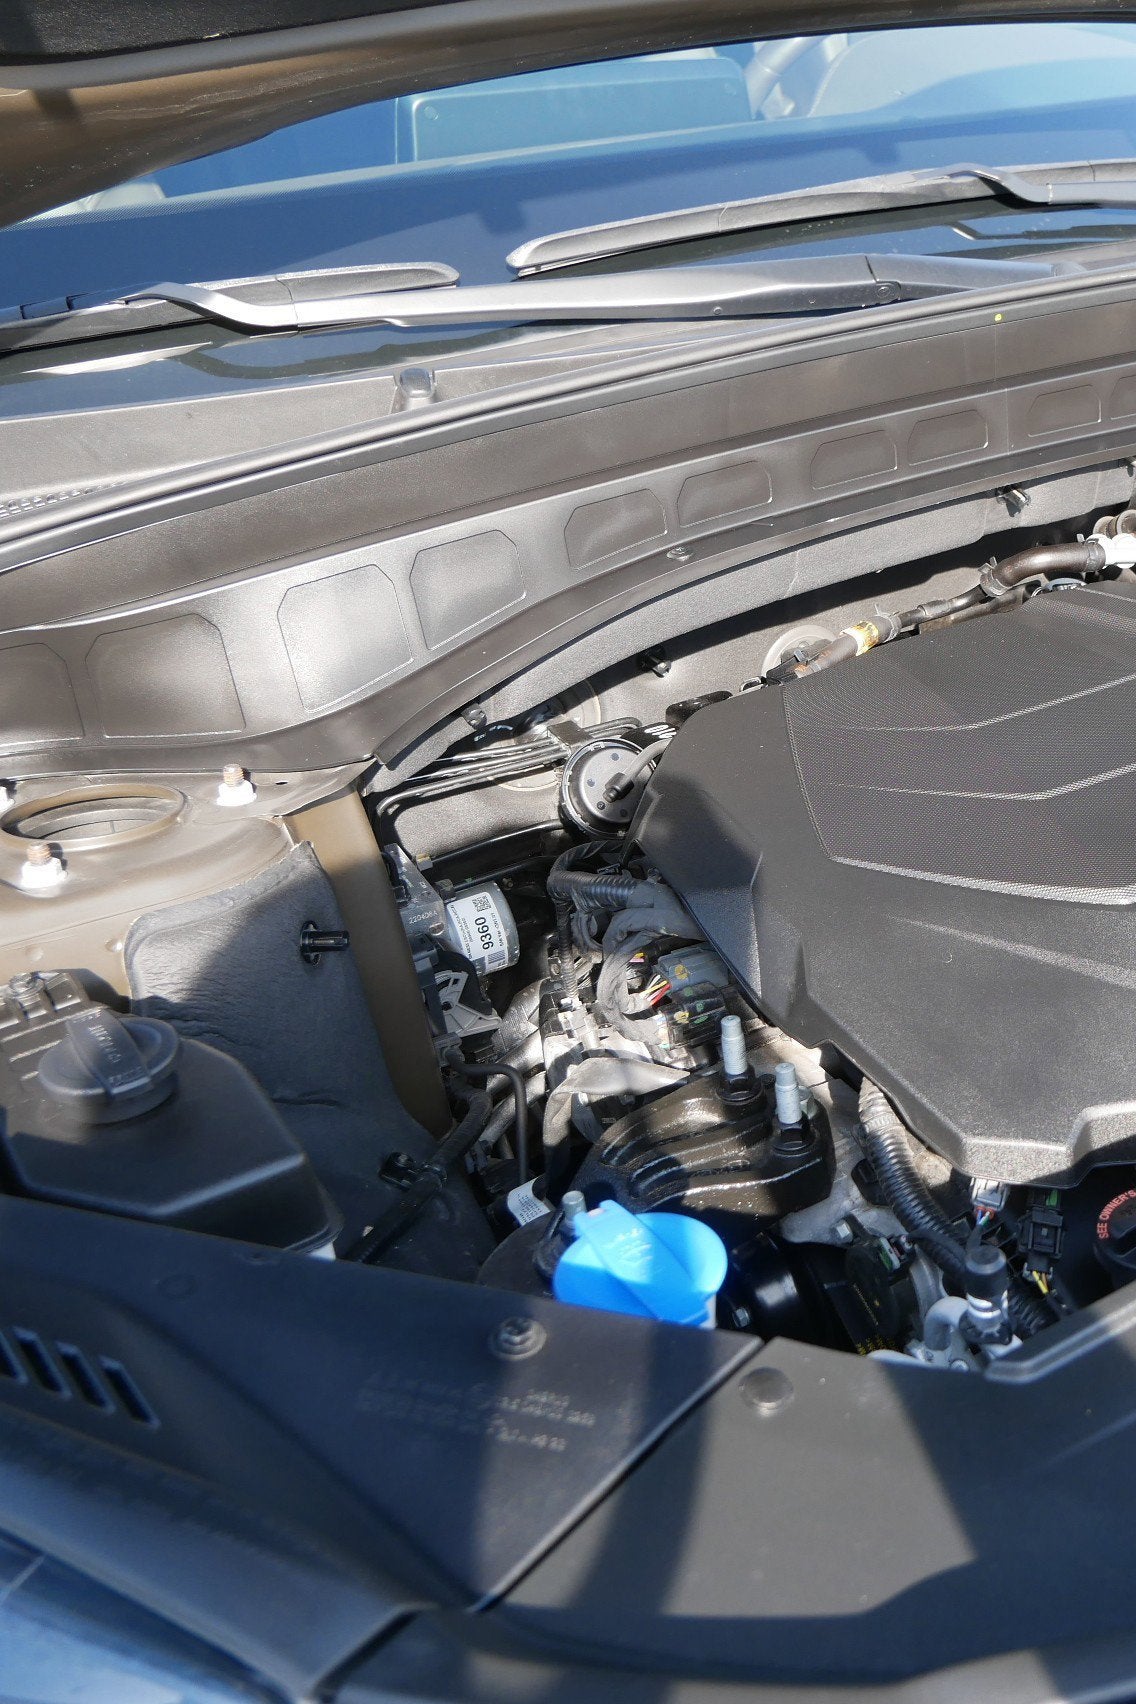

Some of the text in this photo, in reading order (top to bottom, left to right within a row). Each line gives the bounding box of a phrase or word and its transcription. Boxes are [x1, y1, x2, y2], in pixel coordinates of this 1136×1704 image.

[473, 916, 495, 951] 9360
[1098, 1188, 1136, 1221] OWNER'S
[1096, 1221, 1110, 1239] SEE
